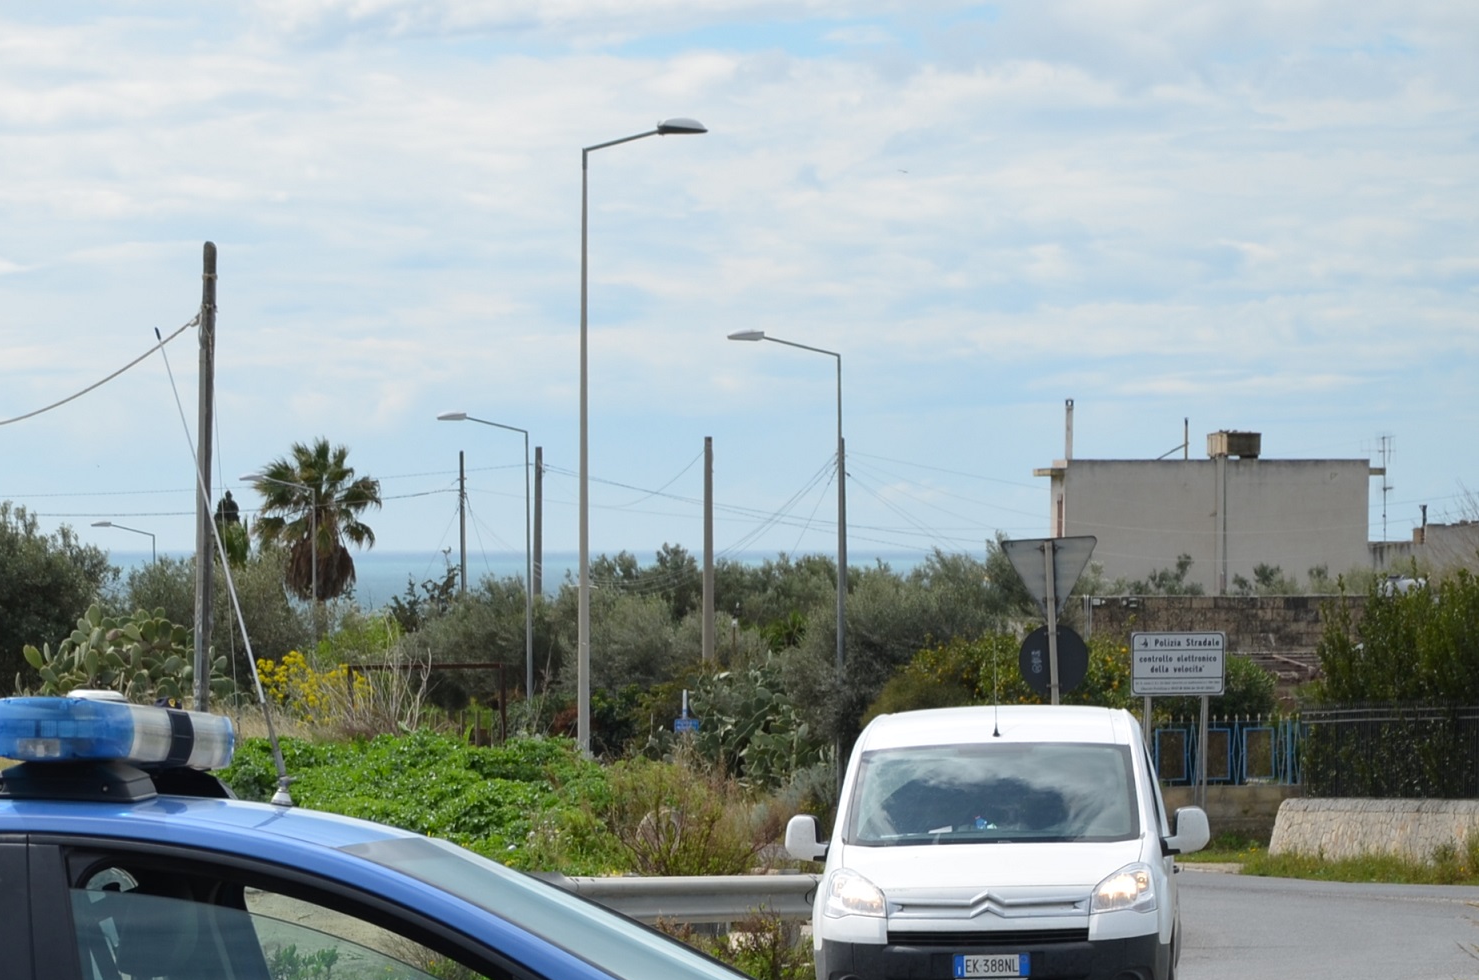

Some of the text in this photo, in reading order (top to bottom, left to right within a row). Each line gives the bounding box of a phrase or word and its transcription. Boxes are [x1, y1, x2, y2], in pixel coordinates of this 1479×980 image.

[1154, 638, 1220, 647] Polizia Stradale
[1139, 654, 1218, 663] controllo elettronico
[1150, 665, 1169, 673] della
